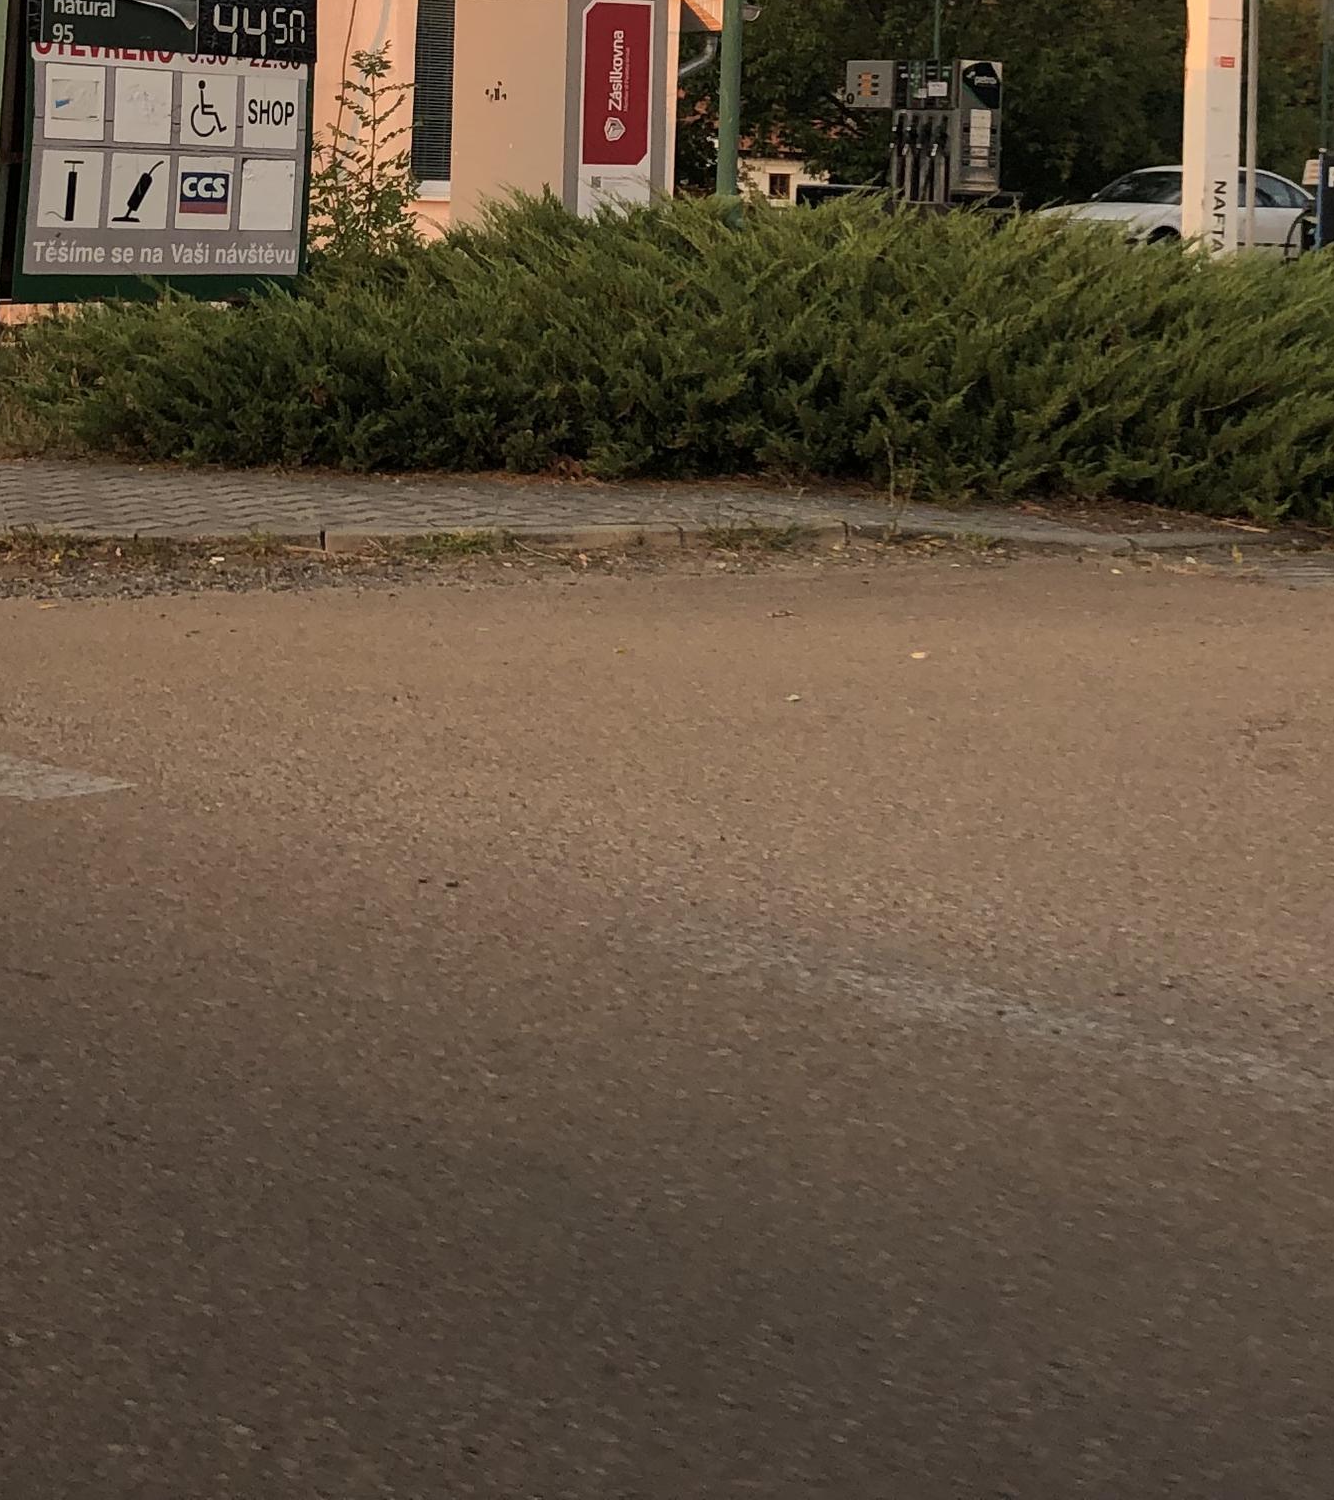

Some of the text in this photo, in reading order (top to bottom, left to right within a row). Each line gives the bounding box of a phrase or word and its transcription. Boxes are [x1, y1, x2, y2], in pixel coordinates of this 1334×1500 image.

[52, 23, 74, 43] 95
[608, 30, 625, 112] Zásilkovna
[247, 99, 295, 126] SHOP
[182, 177, 226, 199] CCS
[1211, 180, 1227, 254] NAFTA
[33, 240, 296, 264] Těšíme se na Vaši návštěvu
